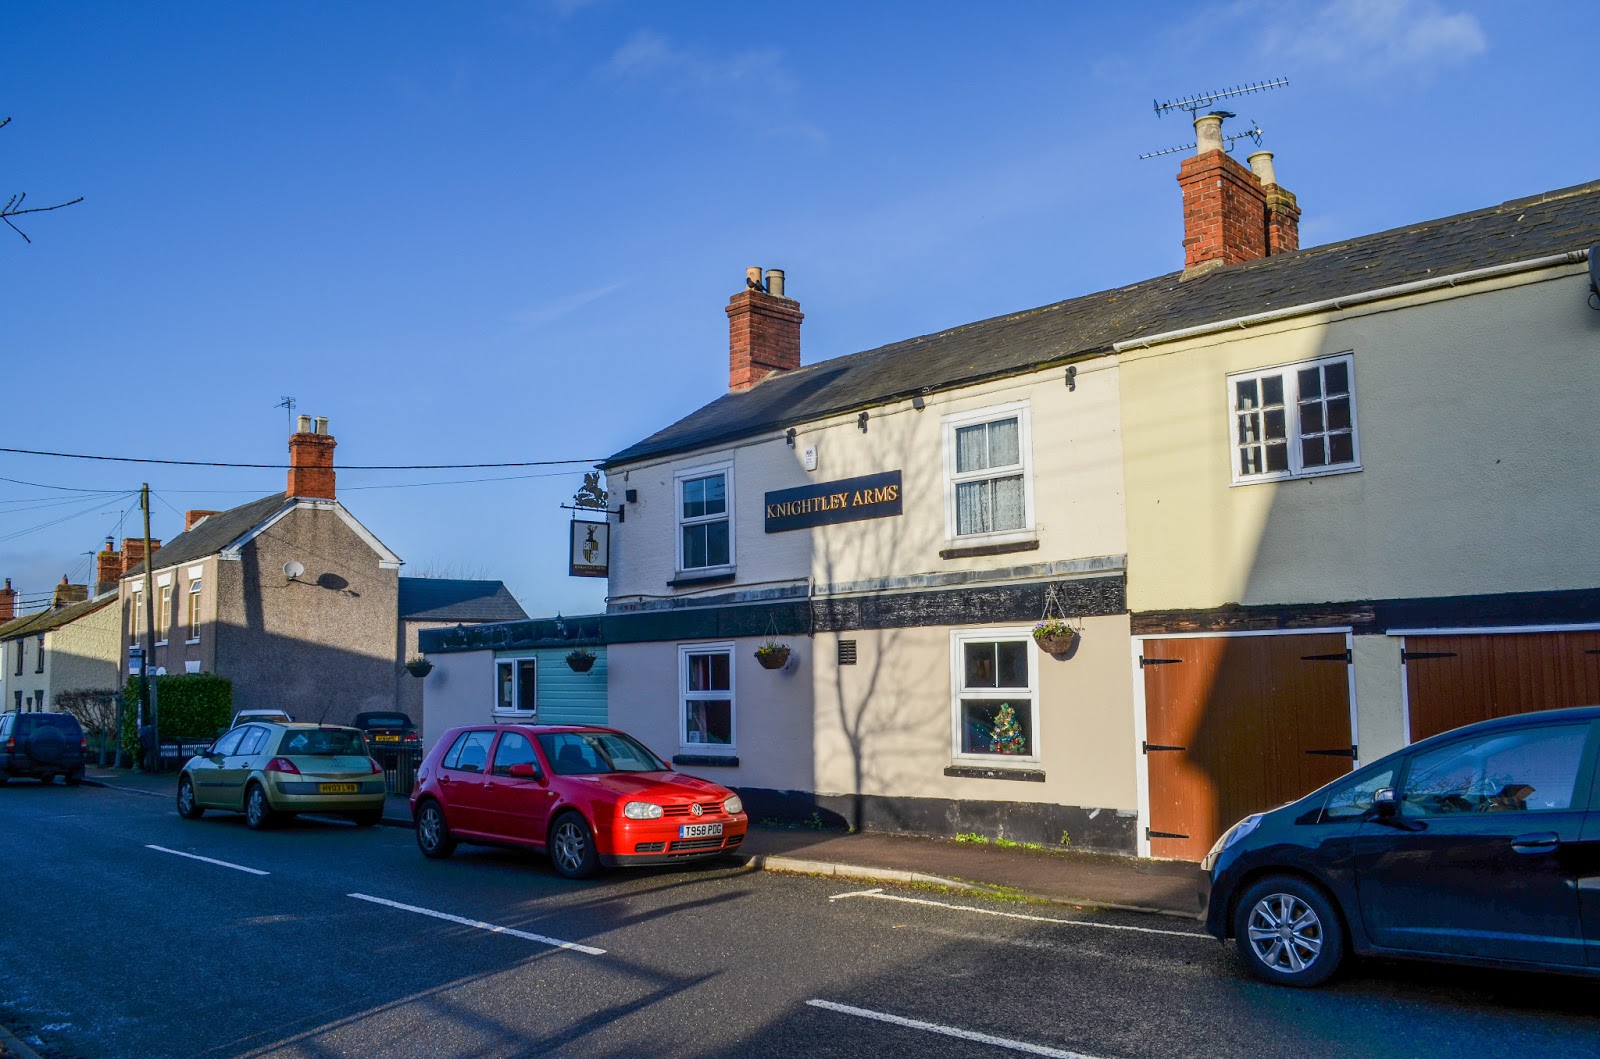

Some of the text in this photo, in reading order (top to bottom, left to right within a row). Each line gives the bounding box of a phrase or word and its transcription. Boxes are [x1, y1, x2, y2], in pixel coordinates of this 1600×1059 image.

[767, 484, 899, 519] KNIGHTLEY ARMS
[685, 824, 722, 836] T958 PDG
